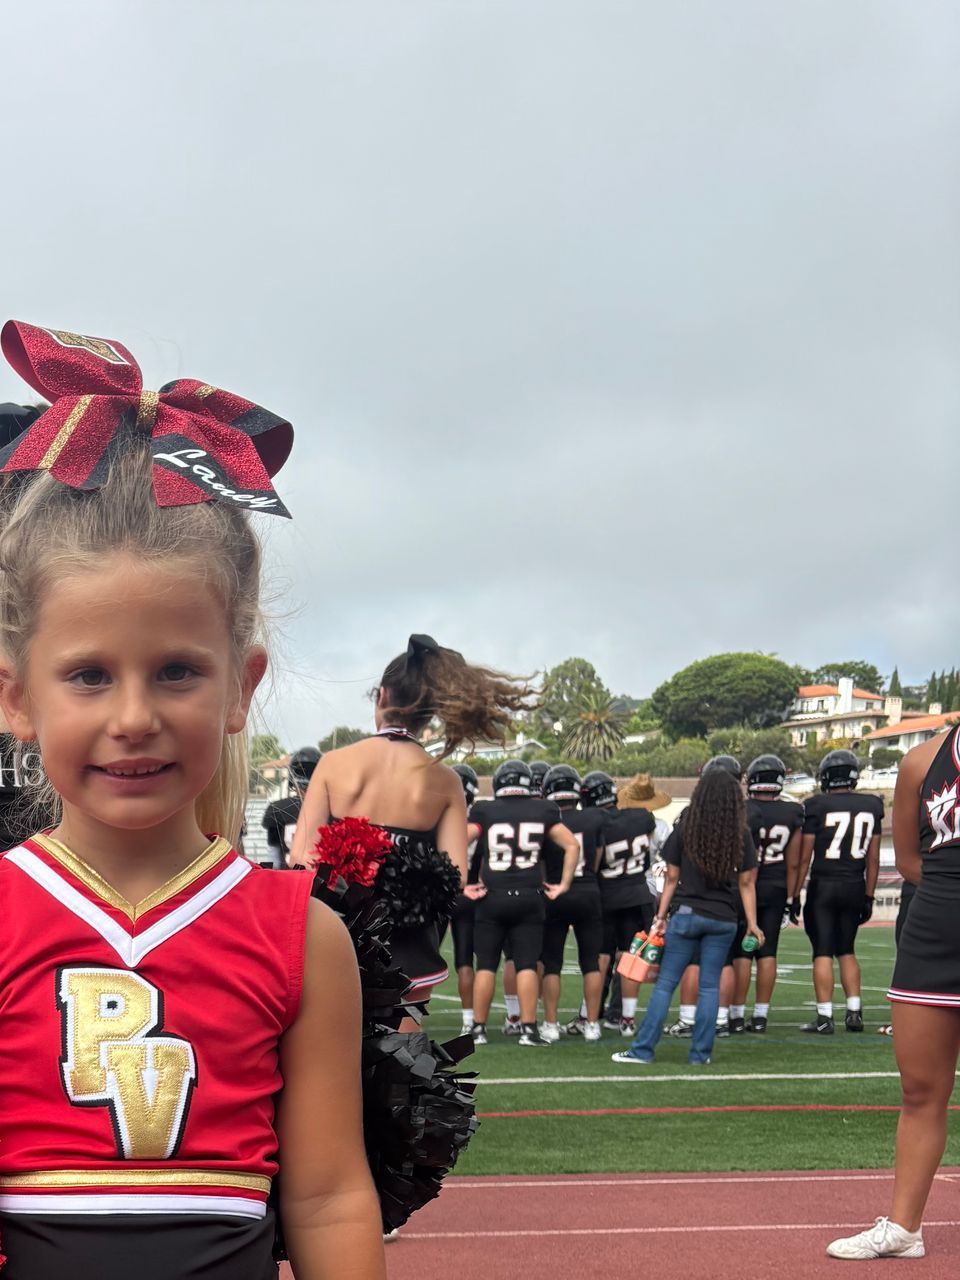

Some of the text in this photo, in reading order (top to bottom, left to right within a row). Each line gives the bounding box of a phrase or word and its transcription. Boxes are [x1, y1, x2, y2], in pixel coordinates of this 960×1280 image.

[152, 448, 279, 509] Laney
[487, 821, 545, 872] 65
[825, 811, 875, 860] 70
[55, 965, 199, 1160] PV
